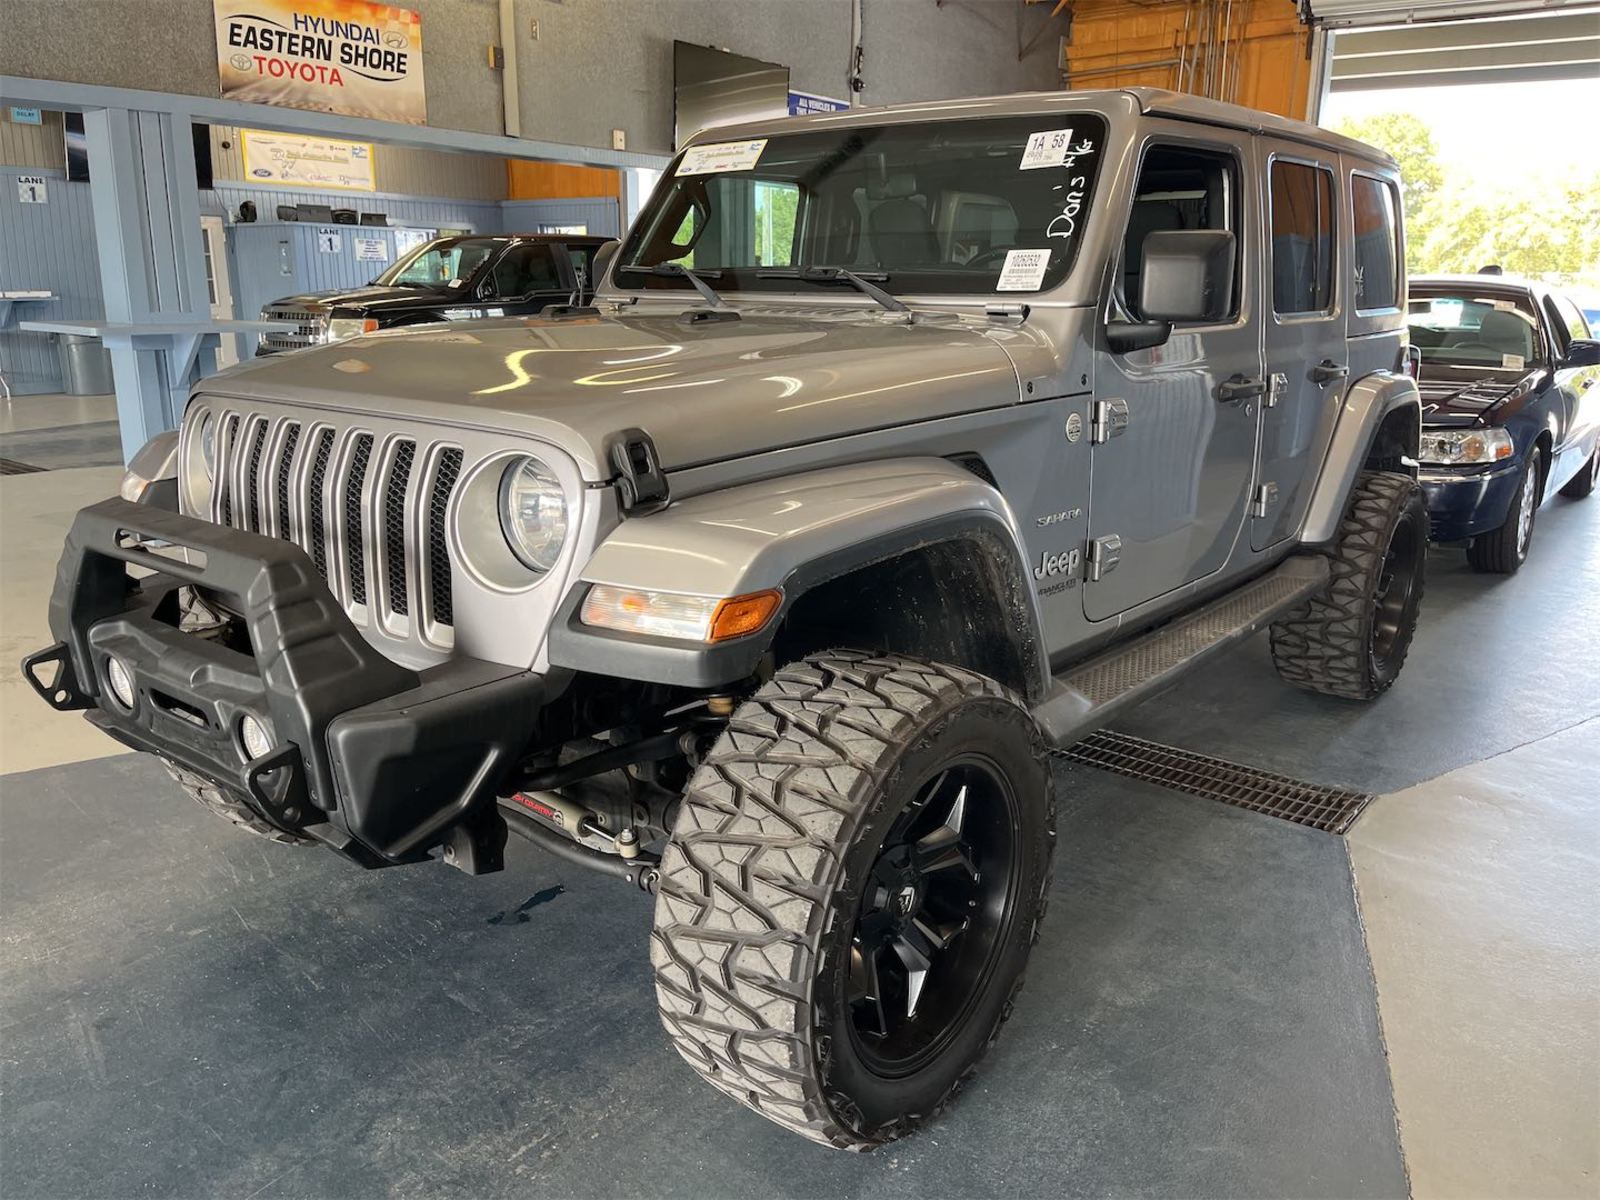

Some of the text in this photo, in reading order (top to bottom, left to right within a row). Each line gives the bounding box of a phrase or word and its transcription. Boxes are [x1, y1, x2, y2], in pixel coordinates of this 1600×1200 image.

[293, 13, 380, 45] HYUNDAI
[228, 22, 408, 74] EASTERN SHORE
[253, 55, 344, 87] TOYOTA
[798, 97, 808, 107] ALL
[808, 99, 830, 112] VEHICLES
[1032, 133, 1066, 151] 1A 58
[29, 186, 37, 201] 1
[327, 237, 333, 251] 1
[1036, 508, 1083, 527] SAHARA
[1033, 548, 1080, 580] Jeep
